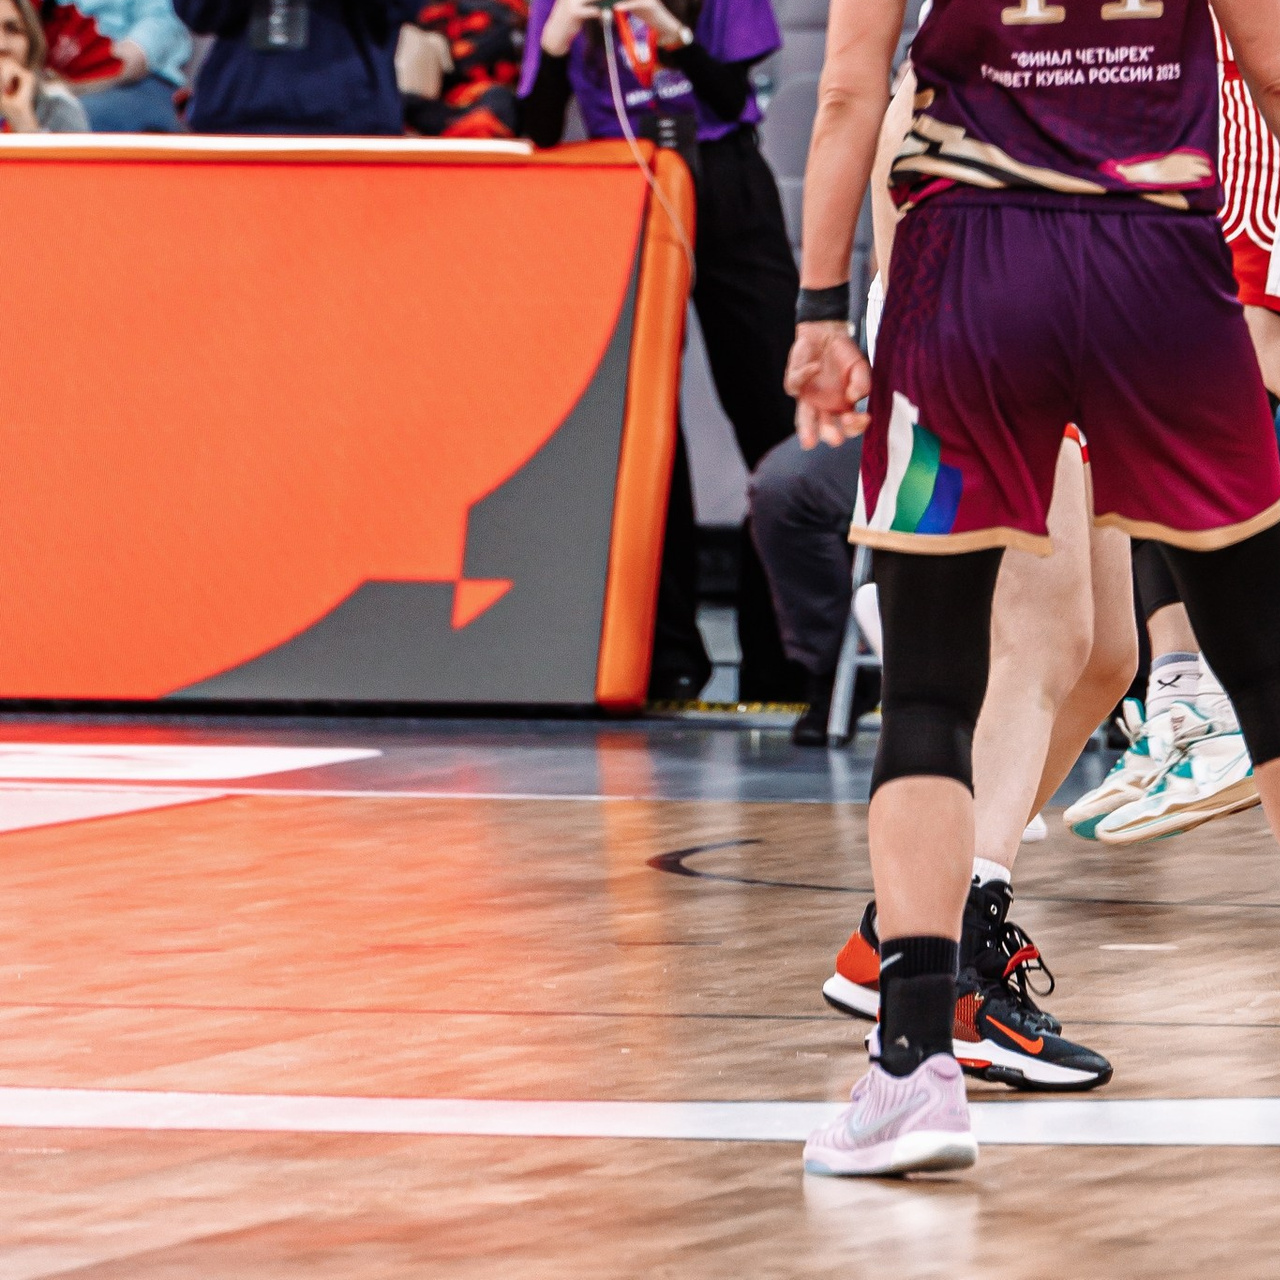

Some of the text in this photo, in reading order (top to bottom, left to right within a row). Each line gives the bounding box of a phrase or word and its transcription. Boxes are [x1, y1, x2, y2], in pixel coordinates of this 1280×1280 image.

[1075, 45, 1155, 65] ЧЕТЫРЕХ"
[1035, 68, 1085, 87] КУБКА
[1088, 65, 1153, 84] РОССИИ
[1156, 62, 1182, 82] 2025
